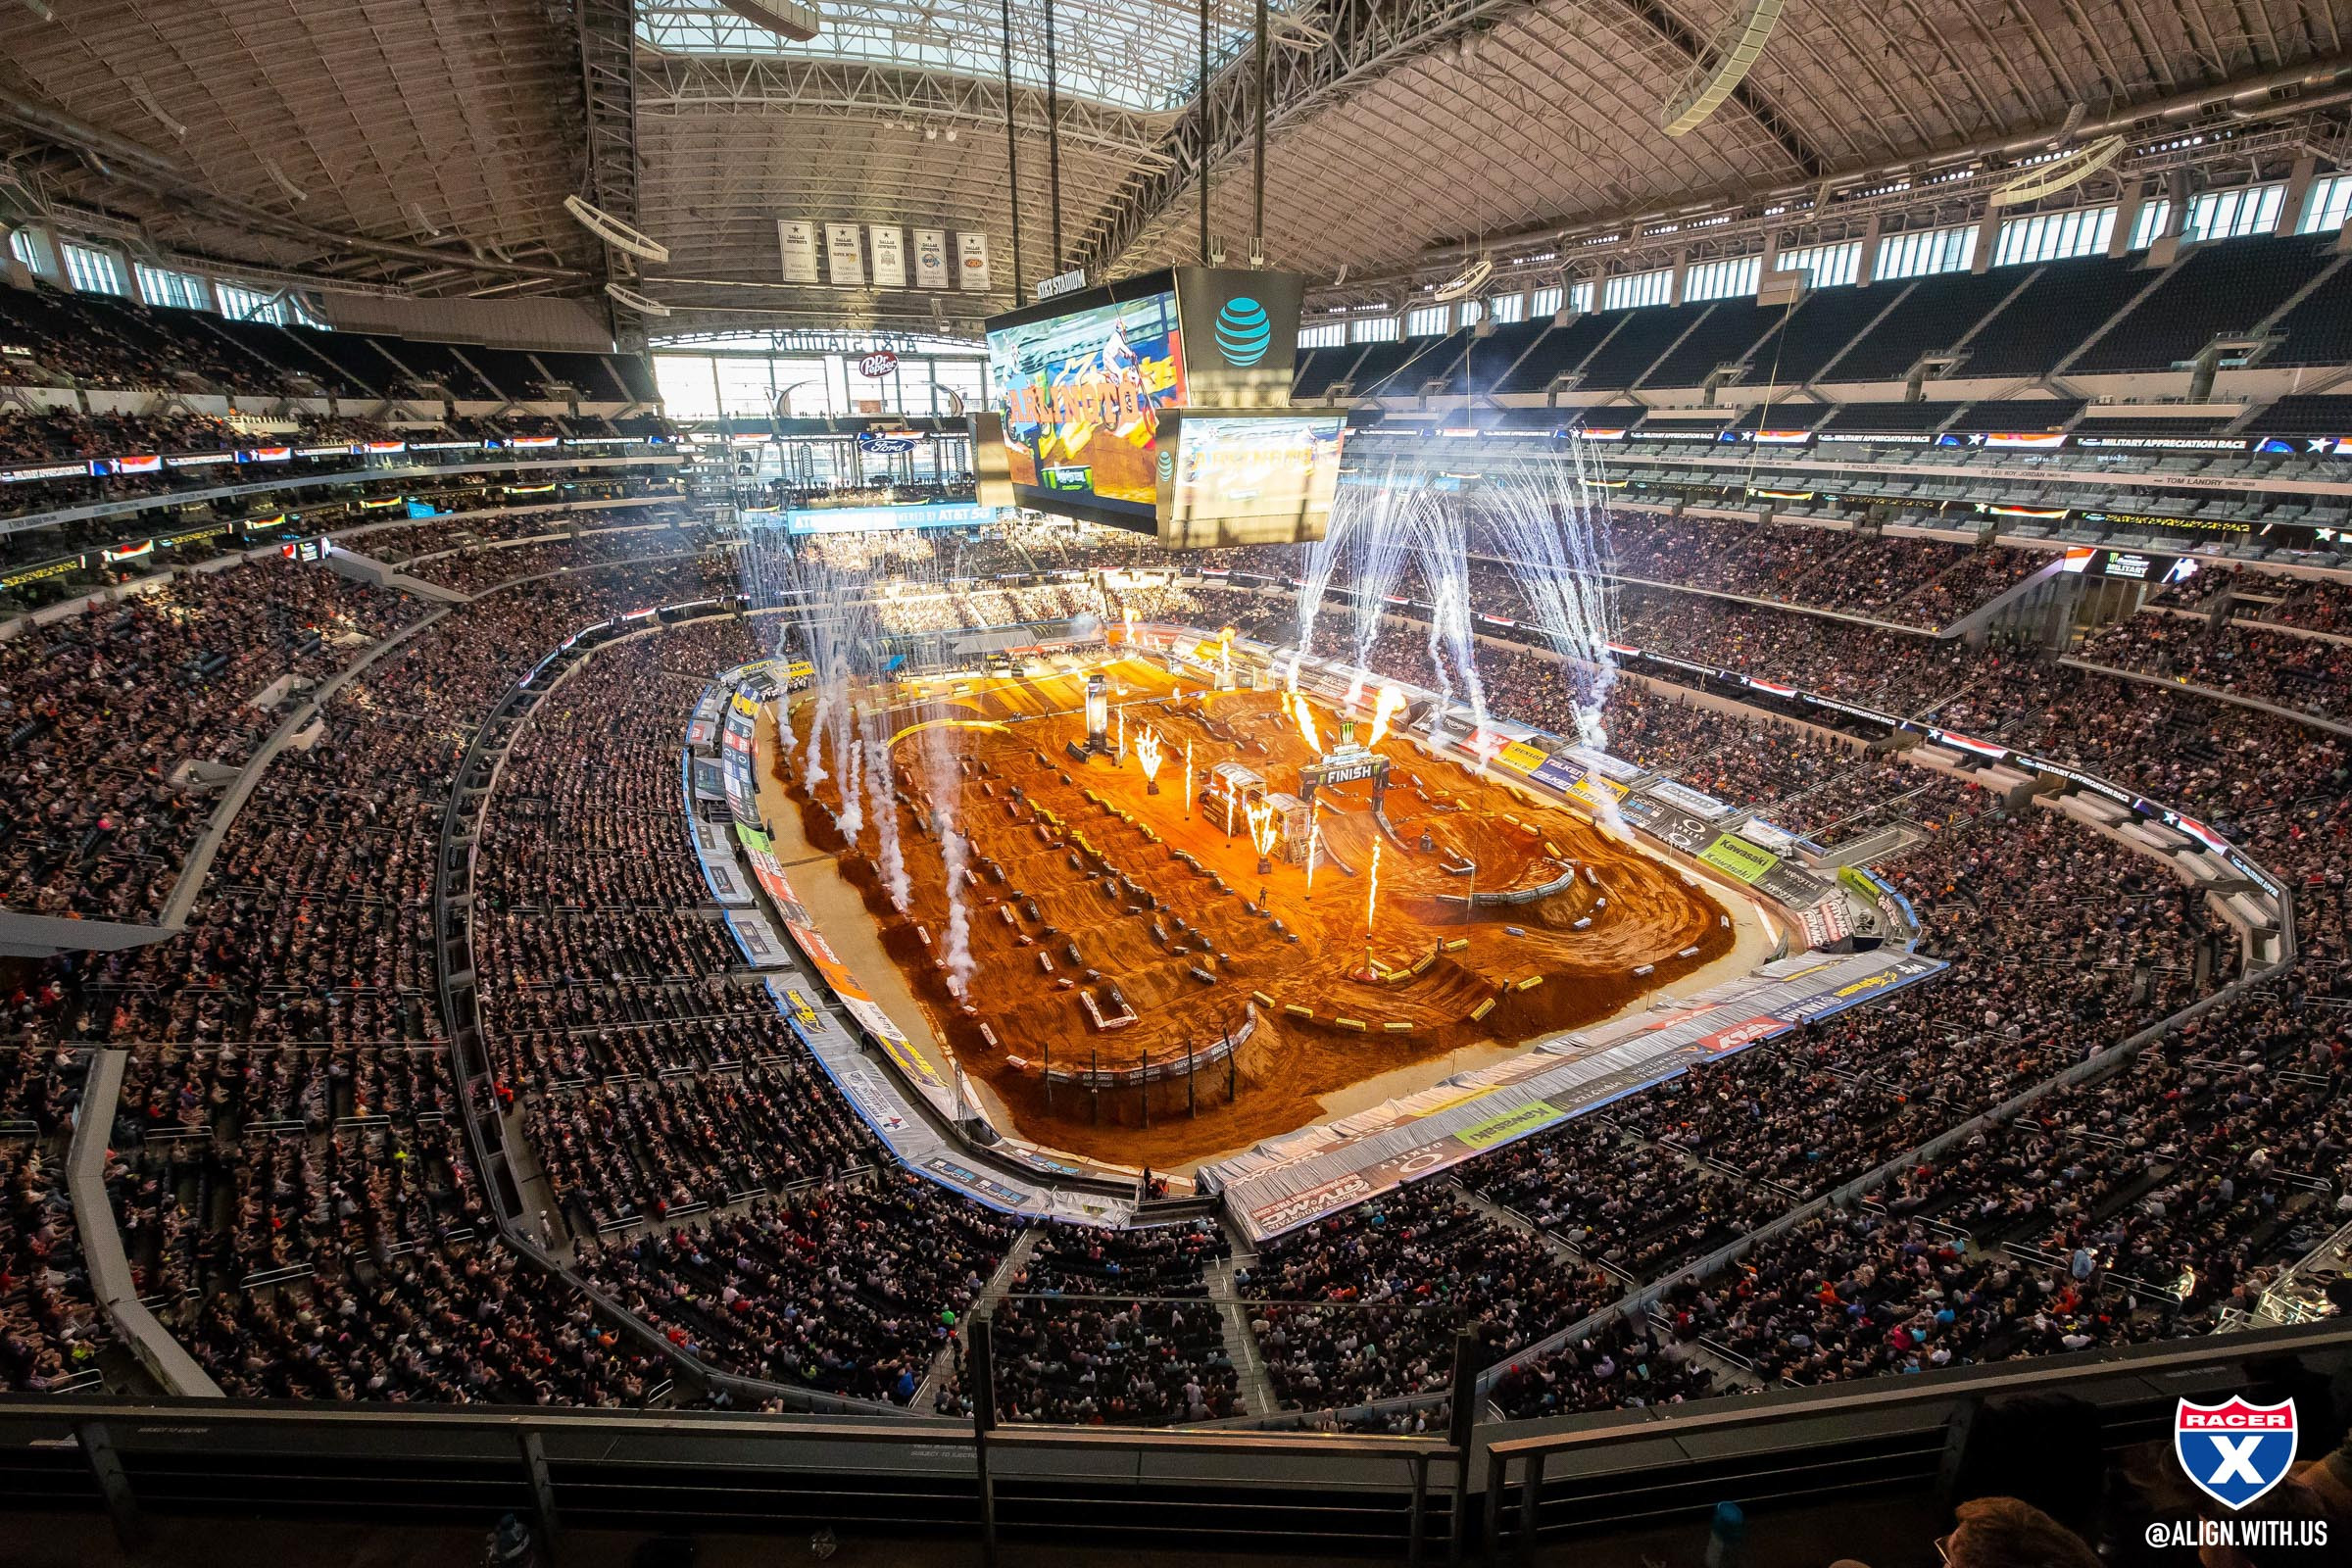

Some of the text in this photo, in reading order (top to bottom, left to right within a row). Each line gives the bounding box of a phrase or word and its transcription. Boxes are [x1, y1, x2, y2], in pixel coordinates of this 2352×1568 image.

[860, 357, 896, 376] Pepper
[875, 355, 888, 365] Dr
[875, 441, 905, 453] Ford
[2143, 439, 2217, 449] APPRECIATION
[2187, 477, 2223, 486] LANDRY
[939, 510, 968, 520] AT&T
[2106, 564, 2148, 574] MILITARY
[742, 662, 772, 673] SUZUKI
[1817, 699, 1896, 725] MILITARY APPRECIATION RACE
[1515, 747, 1544, 762] DUNLOP
[1327, 765, 1372, 784] FINISH
[1546, 759, 1586, 777] FALKEN
[1535, 770, 1573, 790] FALKEN
[2034, 762, 2130, 802] MILITARY APPRECIATION RACE
[1633, 795, 1664, 811] GoPro
[1619, 808, 1651, 825] GoPro
[1672, 821, 1705, 841] OAKLEY
[1719, 839, 1770, 866] Kawasaki
[1704, 852, 1752, 879] Kawasaki
[1784, 868, 1819, 891] MONSTER
[1768, 883, 1801, 904] MONSTER
[1718, 1021, 1782, 1049] FLY
[1632, 1053, 1682, 1076] COMMISSION
[1639, 1064, 1668, 1079] SPORTS
[1568, 1081, 1624, 1103] MONSTER
[1468, 1106, 1550, 1143] Kawasaki
[1380, 1142, 1443, 1170] OAKLEY
[930, 1163, 970, 1183] GoPro
[975, 1183, 1017, 1203] GoPro
[1267, 1192, 1358, 1231] ROCKY MOUNTAIN
